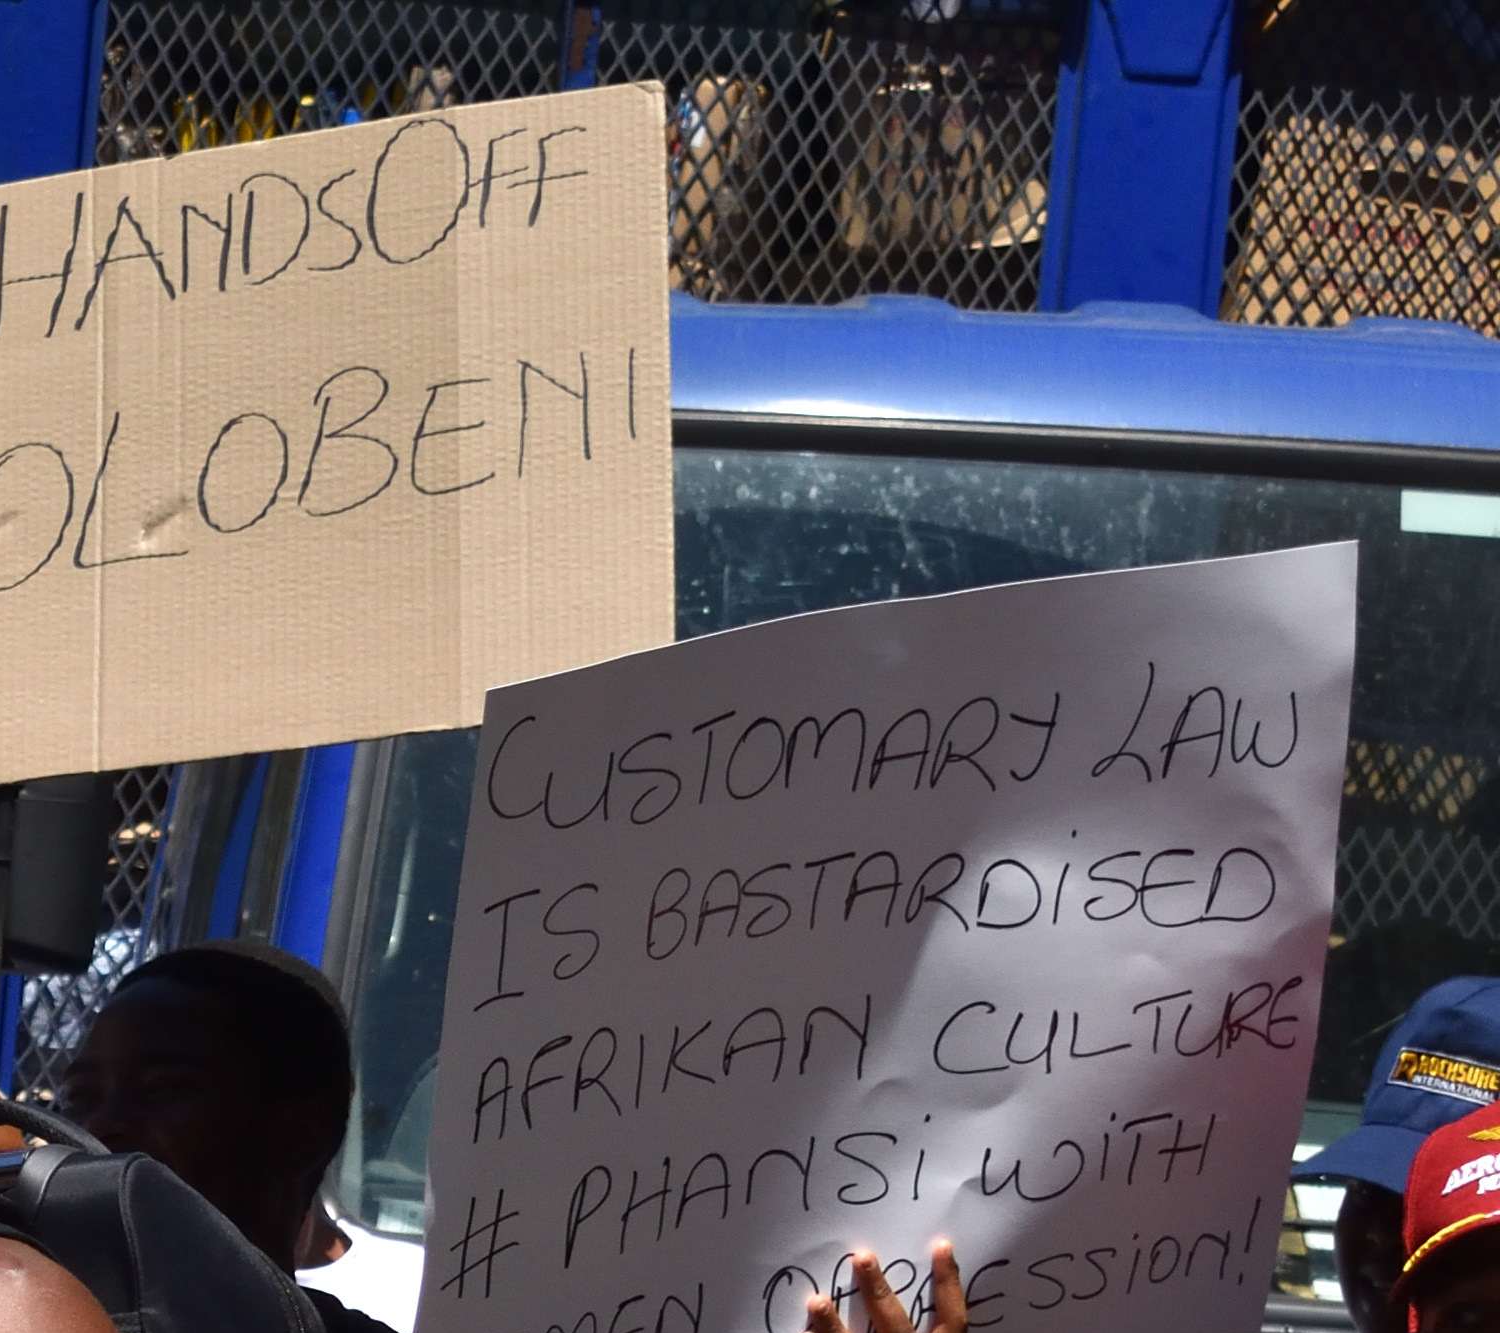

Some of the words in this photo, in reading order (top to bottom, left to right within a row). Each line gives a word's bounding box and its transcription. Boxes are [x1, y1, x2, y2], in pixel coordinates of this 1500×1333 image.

[485, 690, 1063, 831] CUSTOMARY
[1092, 660, 1302, 793] LAW
[473, 883, 601, 1012] IS
[471, 993, 872, 1146] AFRIKAN
[932, 975, 1303, 1076] CULTURE
